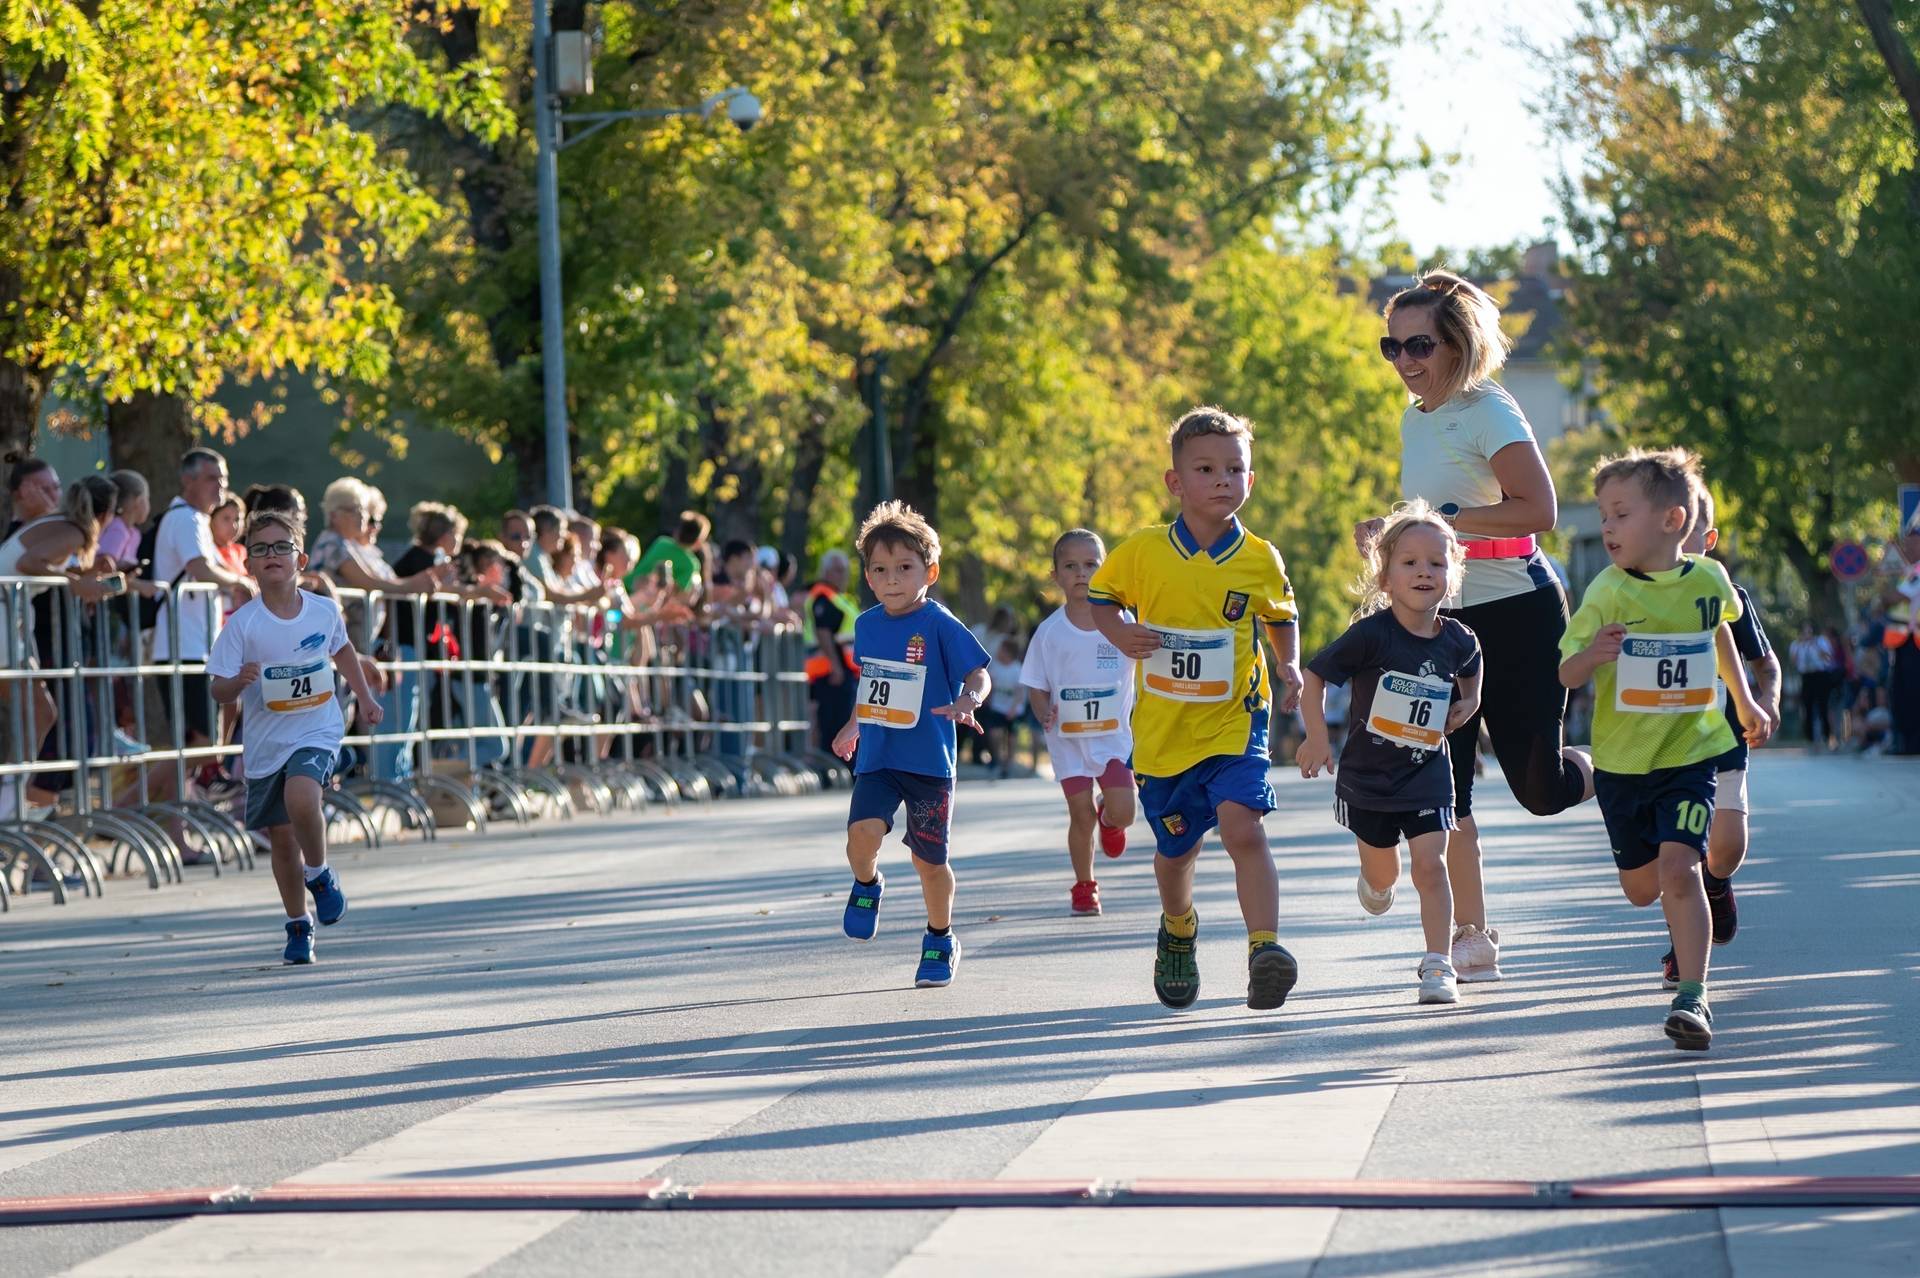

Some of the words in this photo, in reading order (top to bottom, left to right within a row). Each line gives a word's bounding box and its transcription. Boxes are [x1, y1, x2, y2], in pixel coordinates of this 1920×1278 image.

[1695, 596, 1721, 630] 10
[1632, 641, 1663, 649] KOLOR
[1096, 660, 1119, 669] 2025
[1171, 651, 1202, 680] 50
[1657, 659, 1688, 689] 64
[291, 676, 312, 698] 24
[868, 680, 891, 706] 29
[1392, 678, 1418, 690] KOLOR
[1083, 701, 1100, 720] 17
[1408, 699, 1432, 727] 16
[1676, 800, 1708, 835] 10
